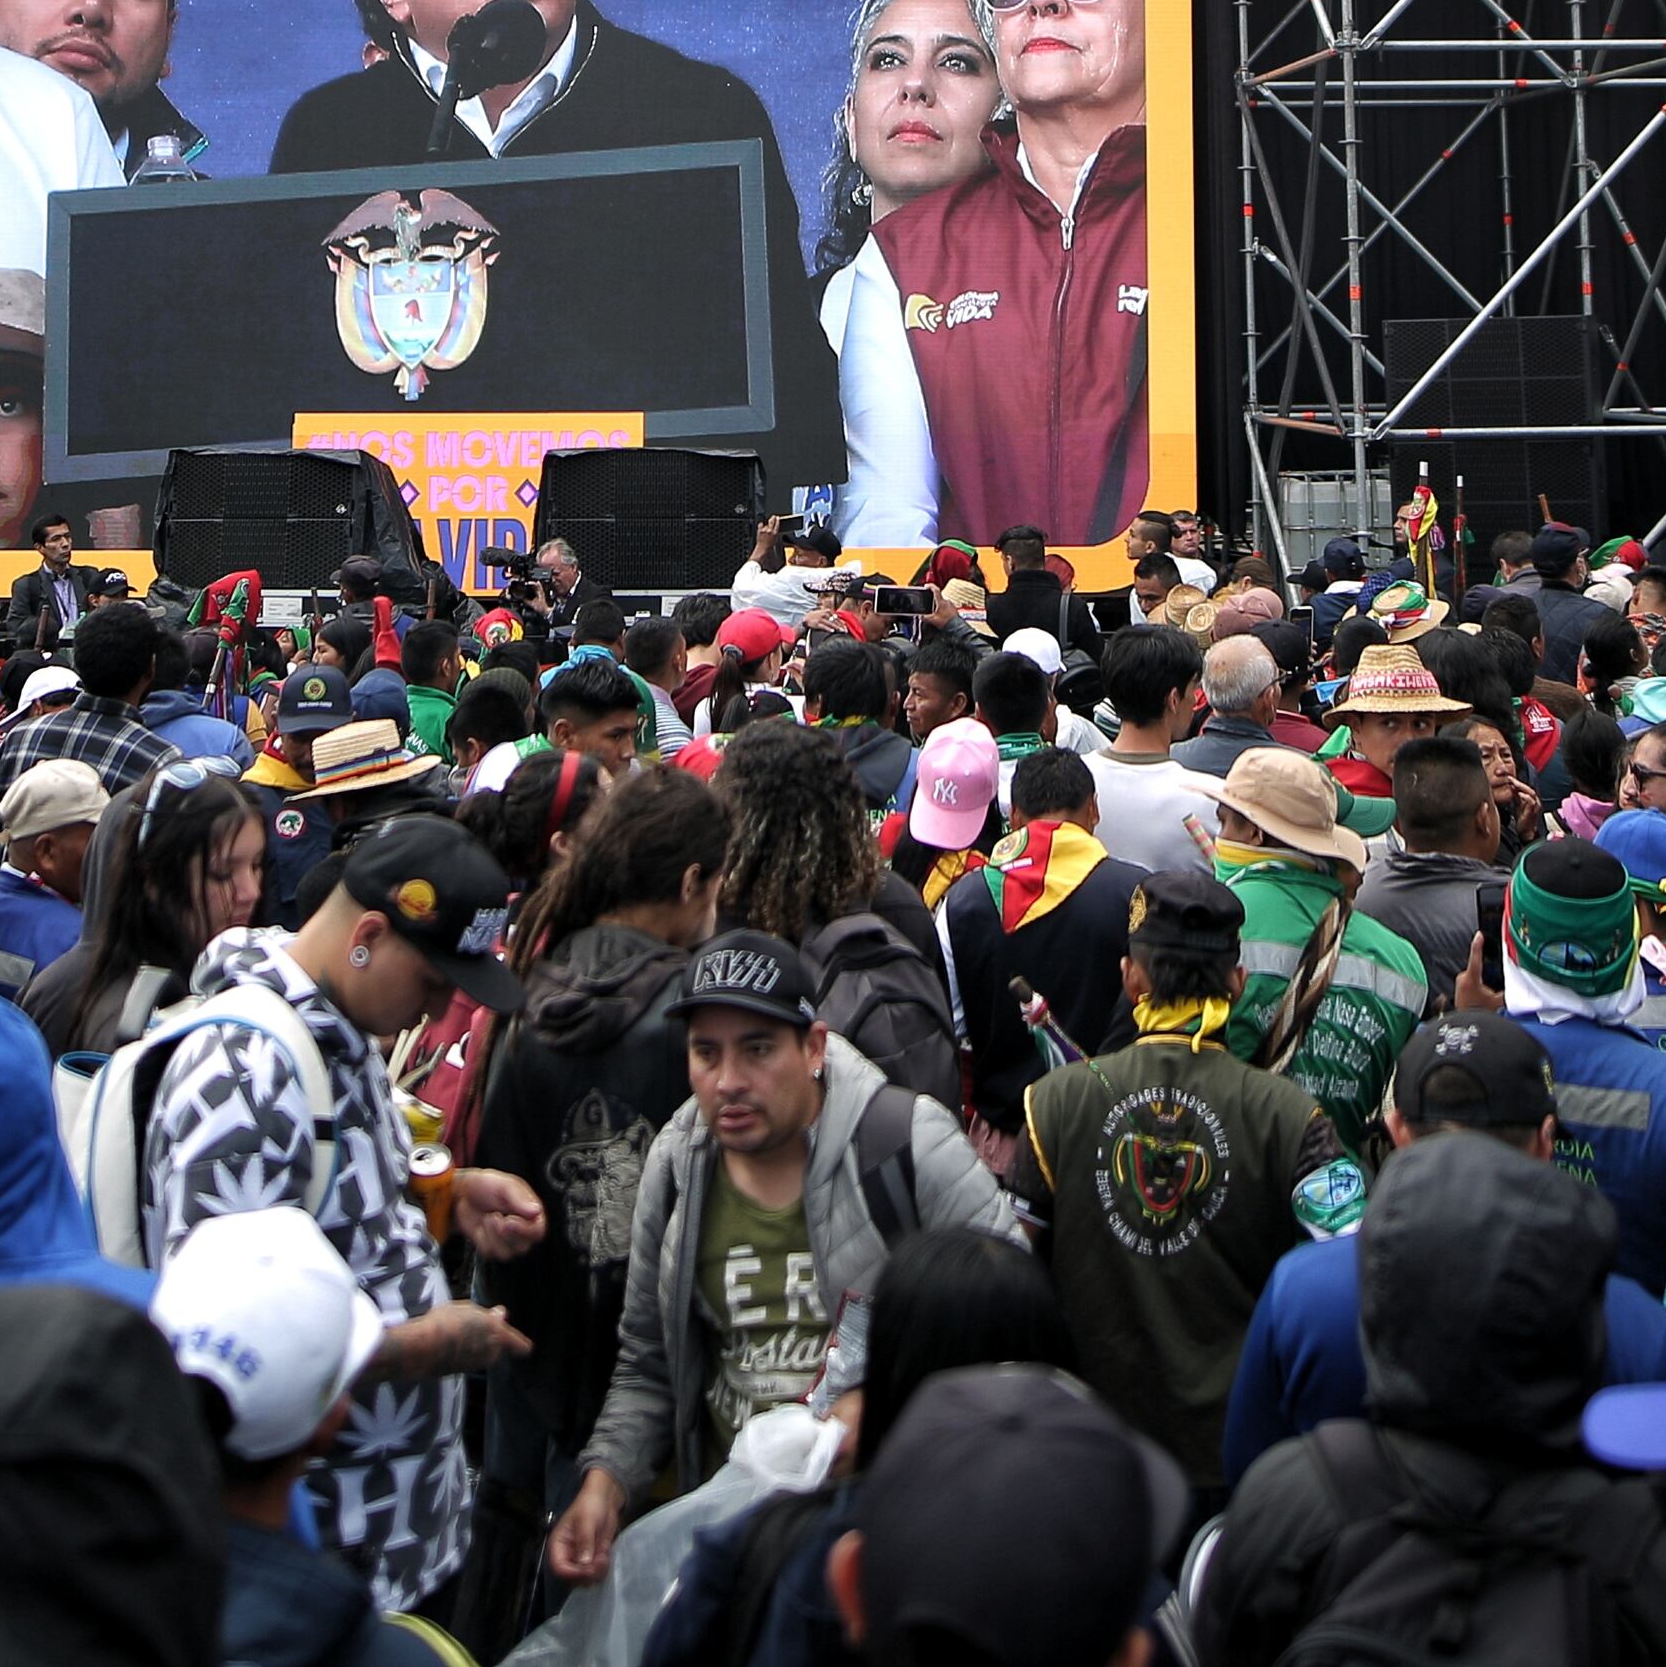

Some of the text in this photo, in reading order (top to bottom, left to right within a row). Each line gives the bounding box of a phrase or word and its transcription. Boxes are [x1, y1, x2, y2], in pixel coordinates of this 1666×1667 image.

[429, 474, 510, 512] POR
[437, 518, 529, 591] VID
[693, 949, 782, 994] KISS
